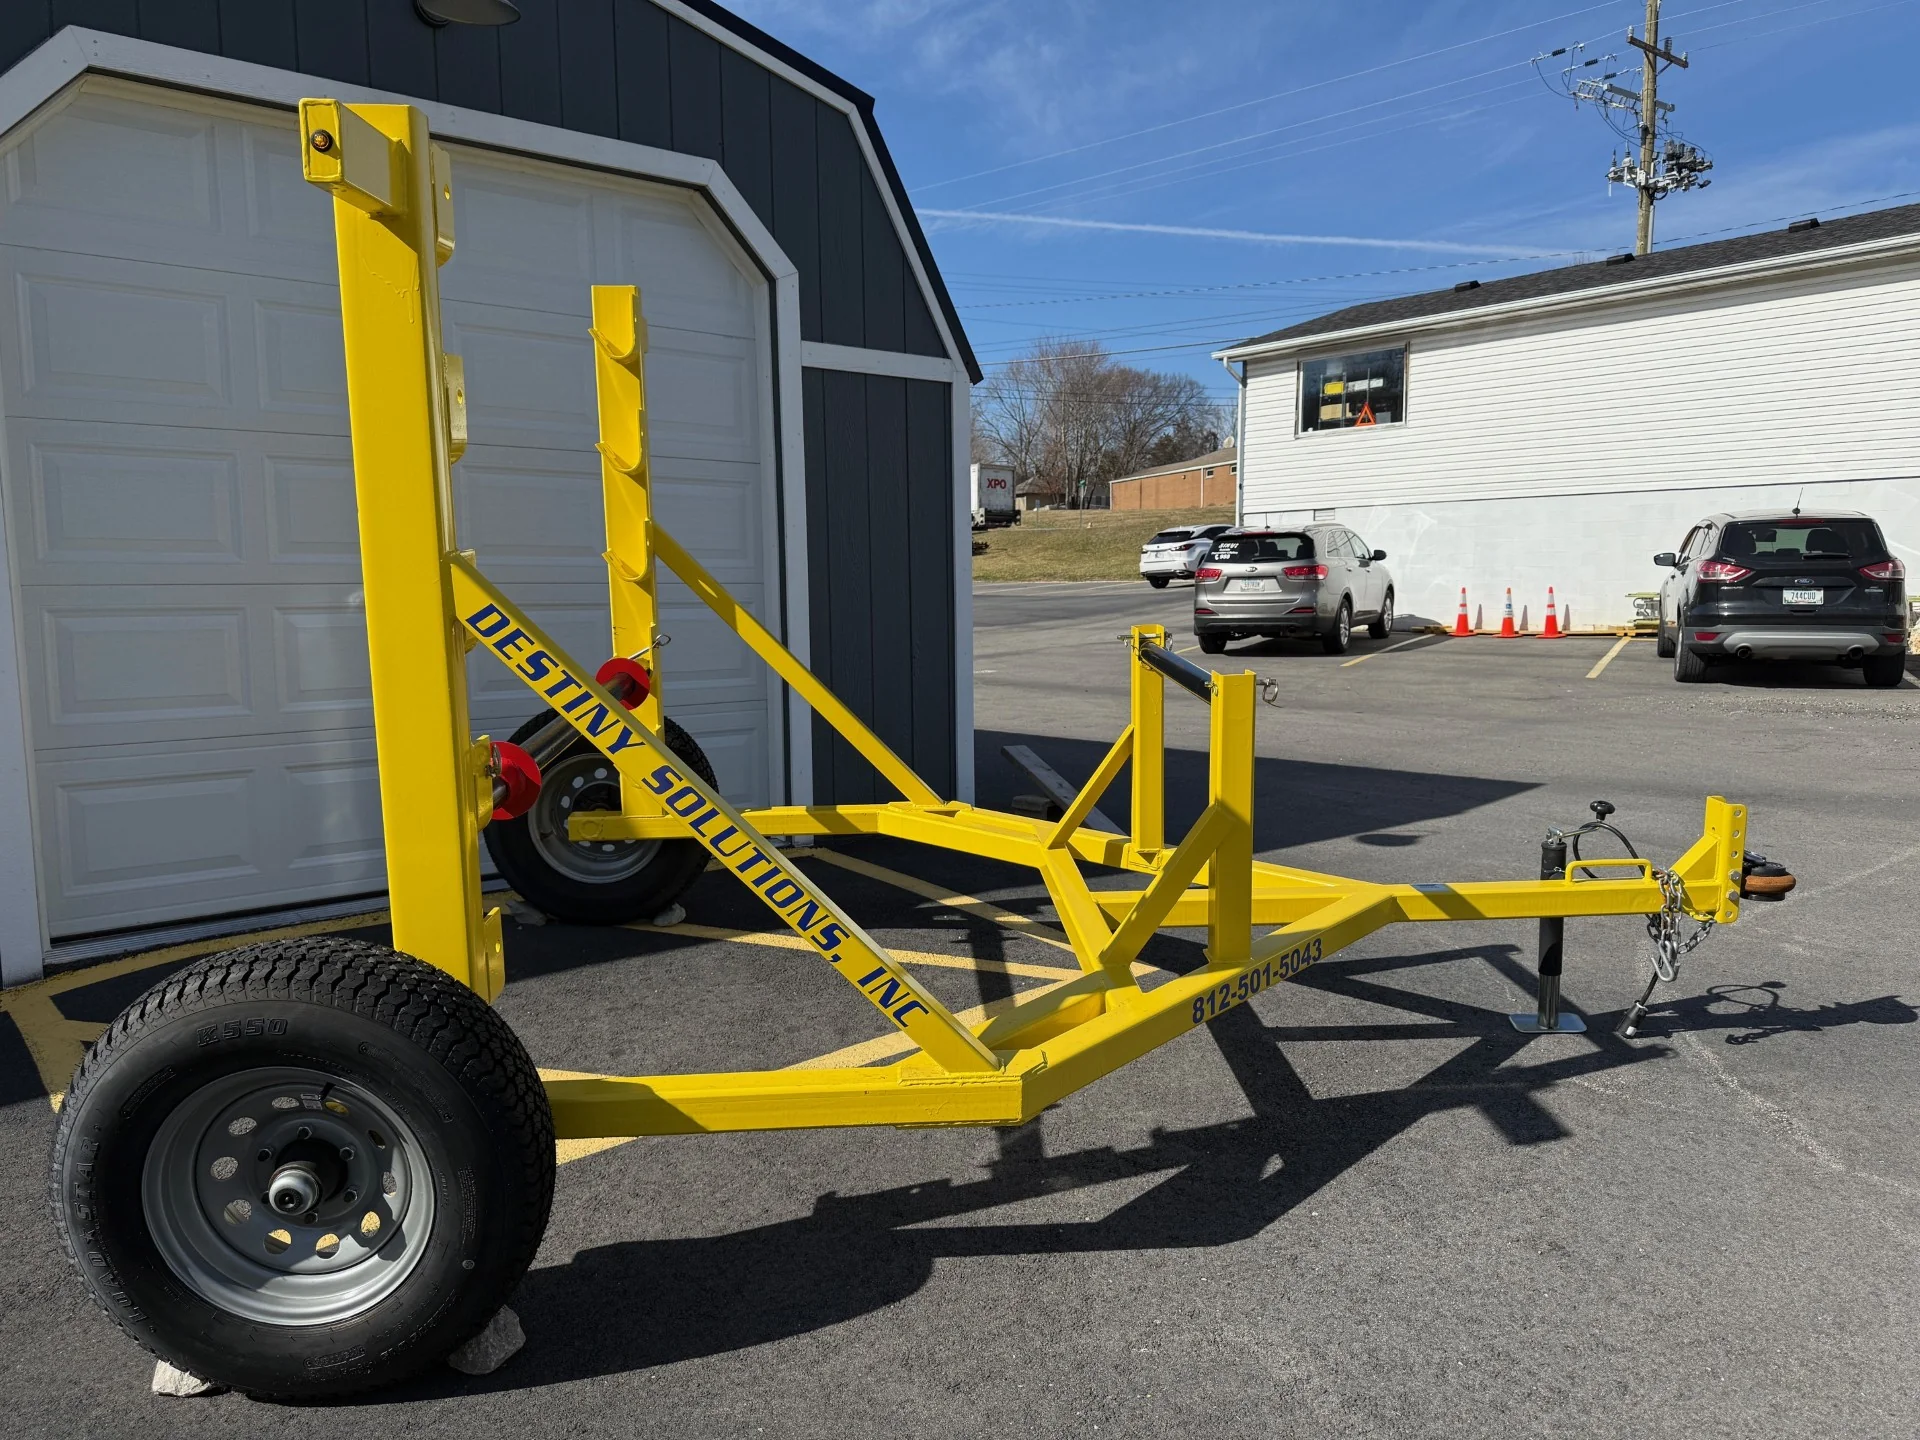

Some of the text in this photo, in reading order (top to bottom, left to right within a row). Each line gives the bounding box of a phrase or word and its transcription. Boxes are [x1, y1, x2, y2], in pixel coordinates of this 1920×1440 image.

[987, 478, 1007, 489] XPO
[465, 603, 929, 1027] DESTINY SOLUTIONS, INC
[1192, 938, 1322, 1024] 812-501-5043
